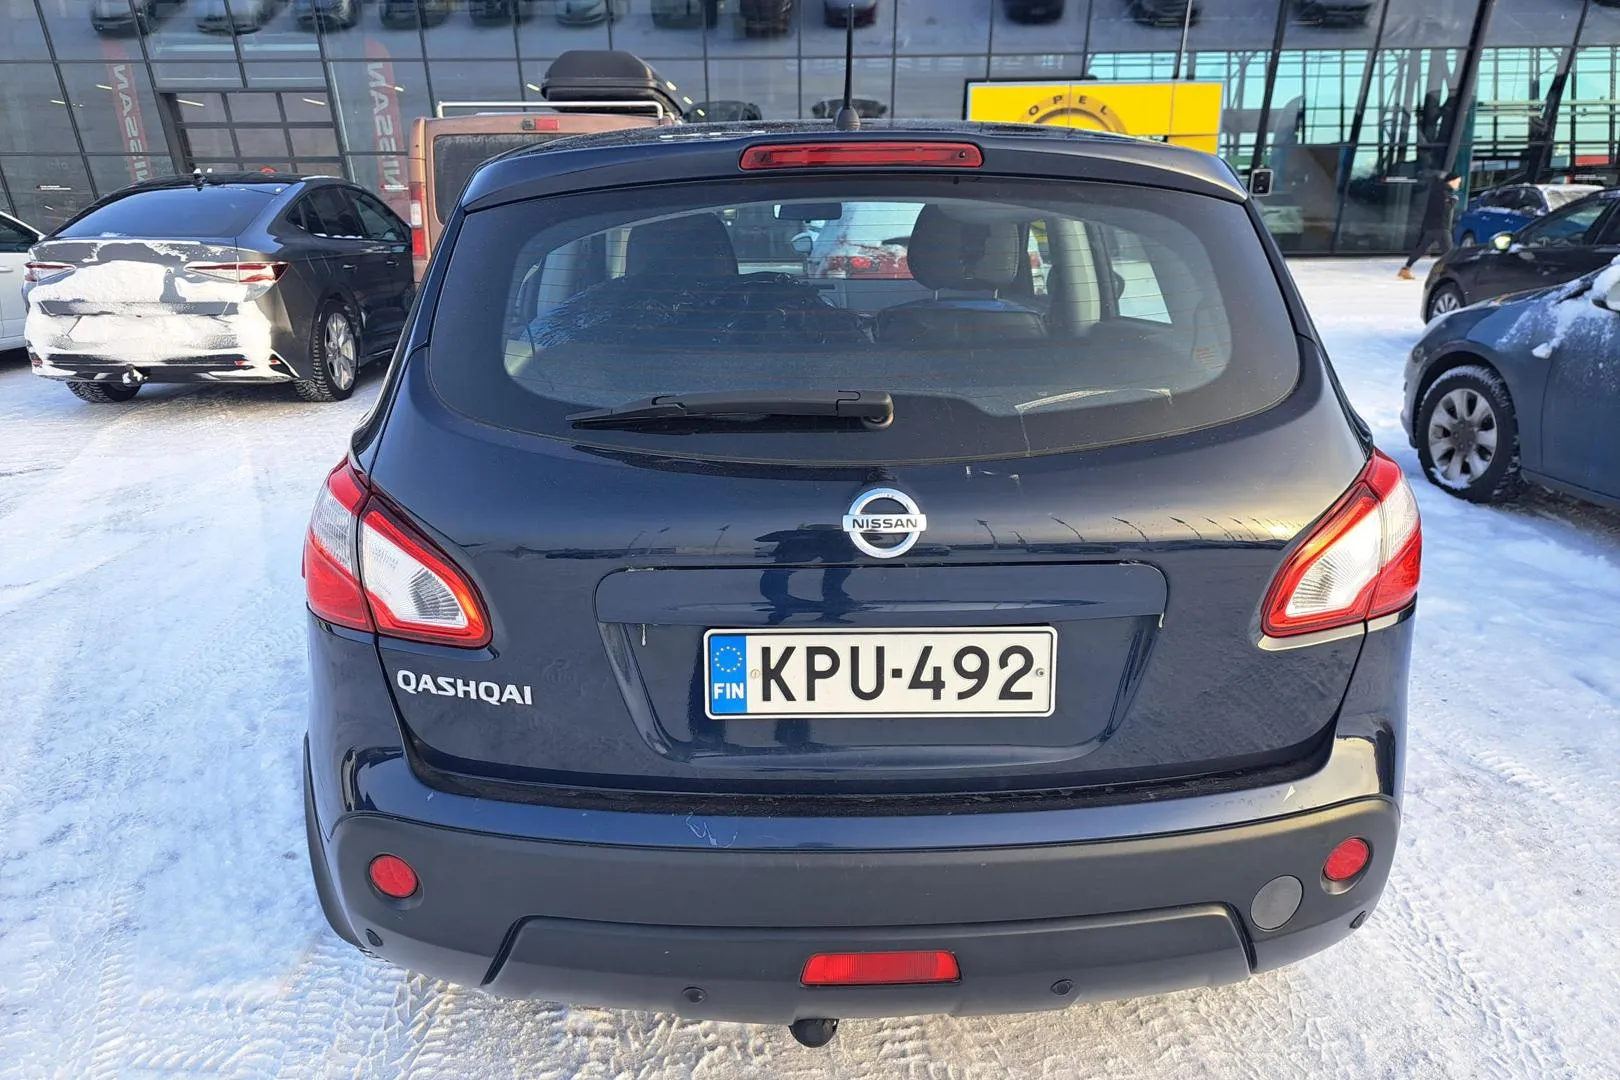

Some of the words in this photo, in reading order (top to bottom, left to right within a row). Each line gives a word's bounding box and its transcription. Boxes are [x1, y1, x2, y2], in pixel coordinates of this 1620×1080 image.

[1028, 94, 1107, 116] OPEL
[852, 518, 918, 529] NISSAN
[761, 645, 1034, 702] KPU-492
[396, 669, 533, 705] QASHQAI
[713, 683, 744, 700] FIN
